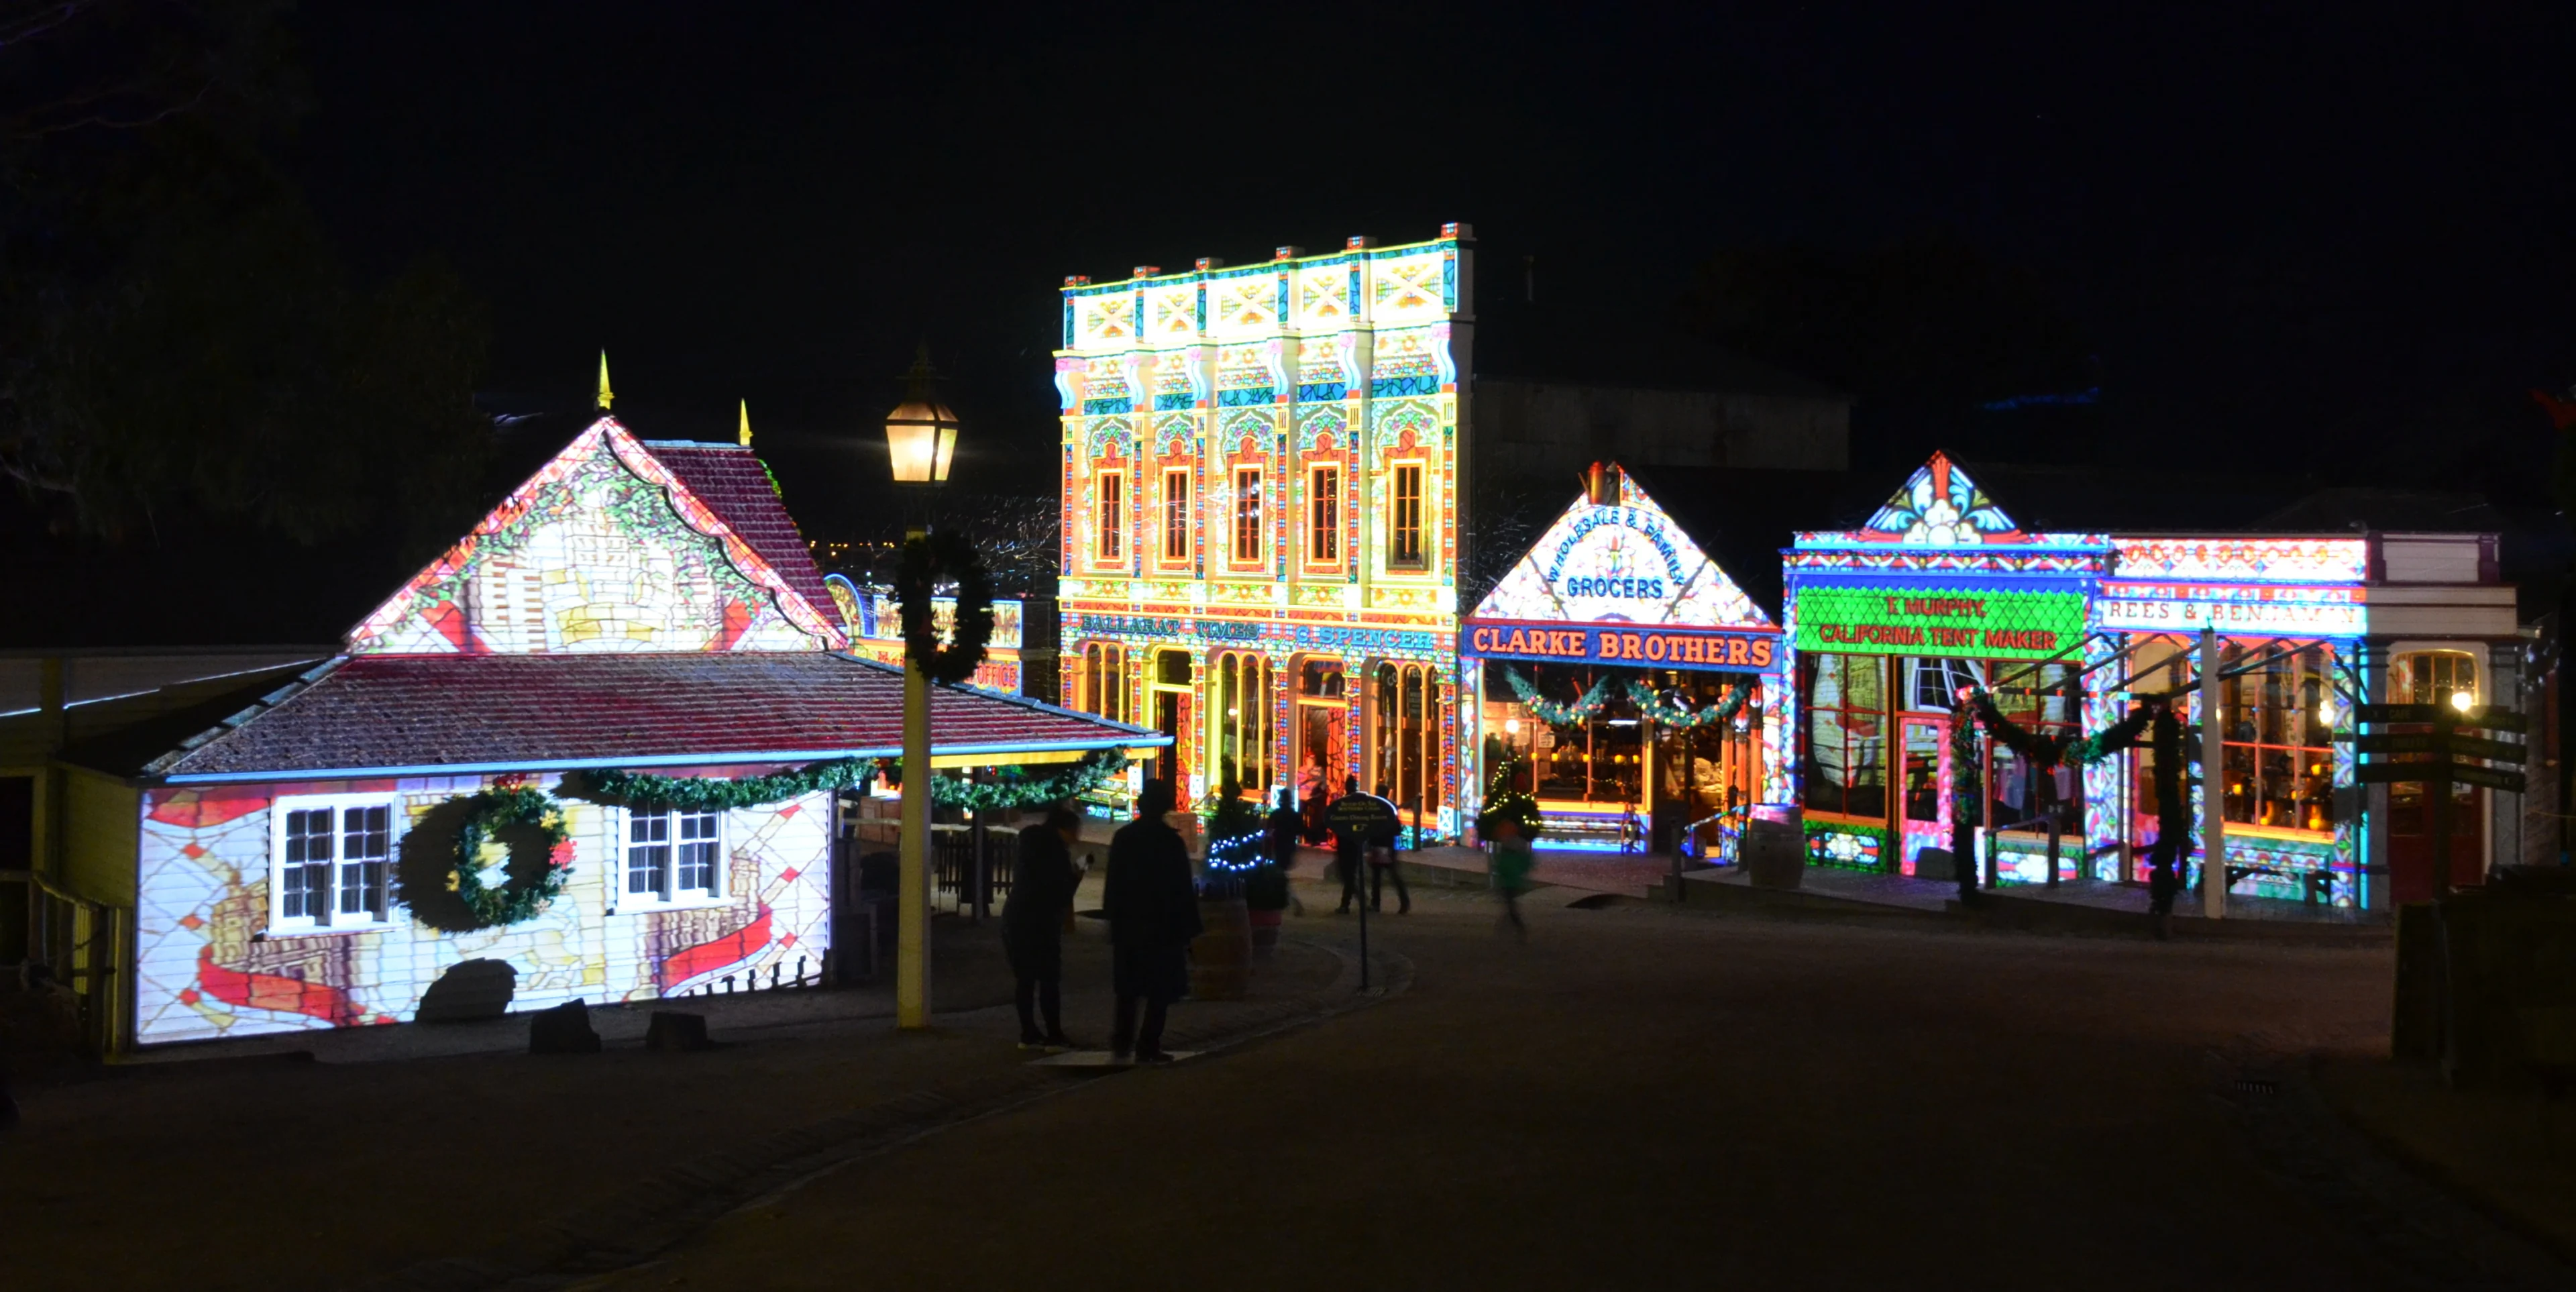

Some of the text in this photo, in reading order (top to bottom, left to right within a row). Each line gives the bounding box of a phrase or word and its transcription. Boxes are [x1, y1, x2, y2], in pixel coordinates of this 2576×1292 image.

[1548, 506, 1685, 586] WHOLESALE & FAMILY
[1567, 577, 1663, 598] GROCERS
[2110, 601, 2355, 623] REES & BENJAMN
[1081, 614, 1260, 640] BALLARAT TIMES
[1319, 627, 1434, 649] SPENCER
[1819, 624, 2057, 650] CALIFORNIA TENT MAKER
[1473, 628, 1773, 667] CLARKE BROTHERS
